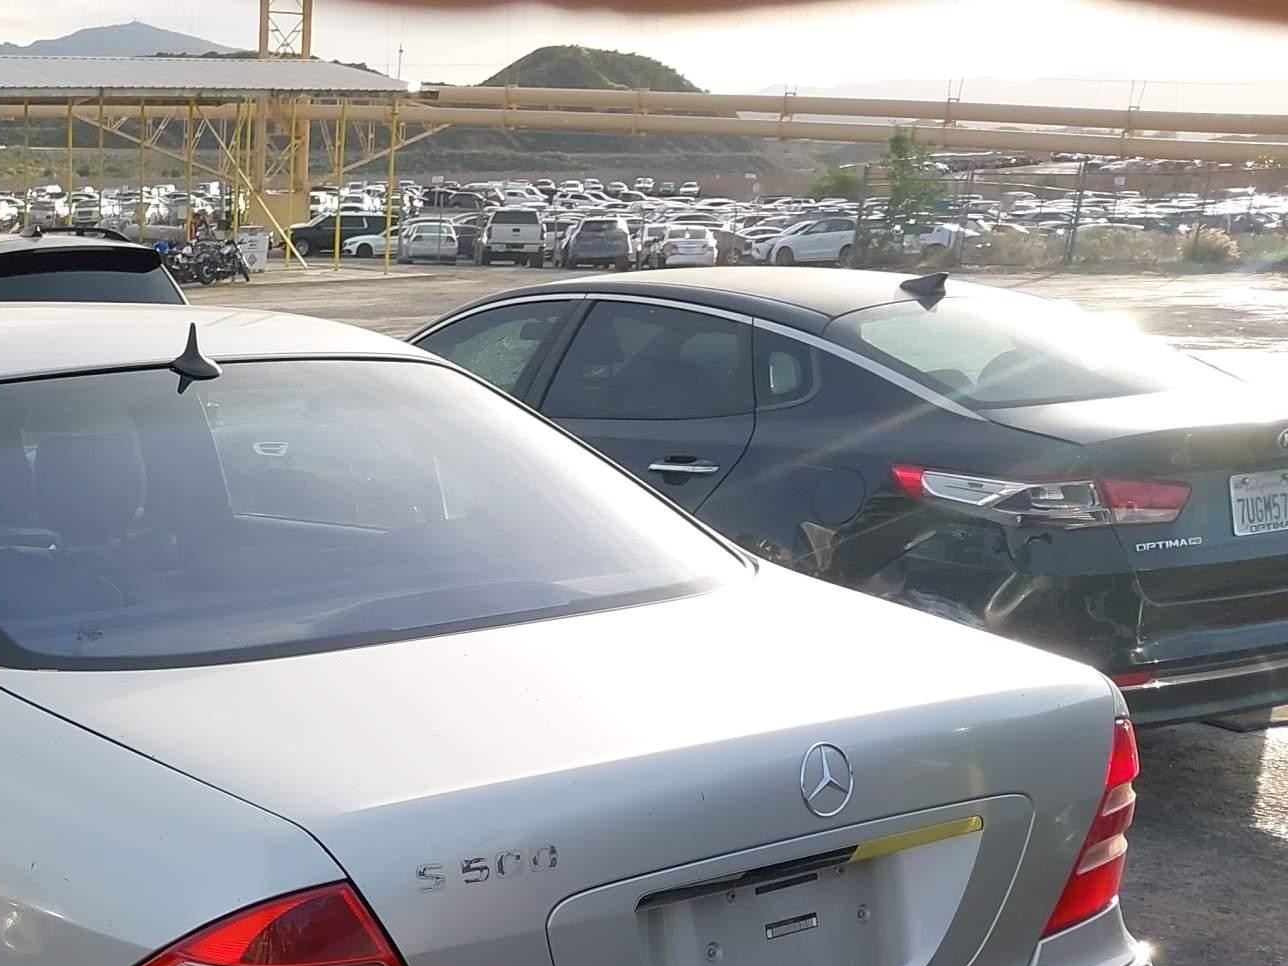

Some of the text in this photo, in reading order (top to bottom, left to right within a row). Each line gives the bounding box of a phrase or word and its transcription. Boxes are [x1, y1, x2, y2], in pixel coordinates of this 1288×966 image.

[1135, 538, 1188, 552] OPTIMA
[416, 845, 559, 893] S 500
